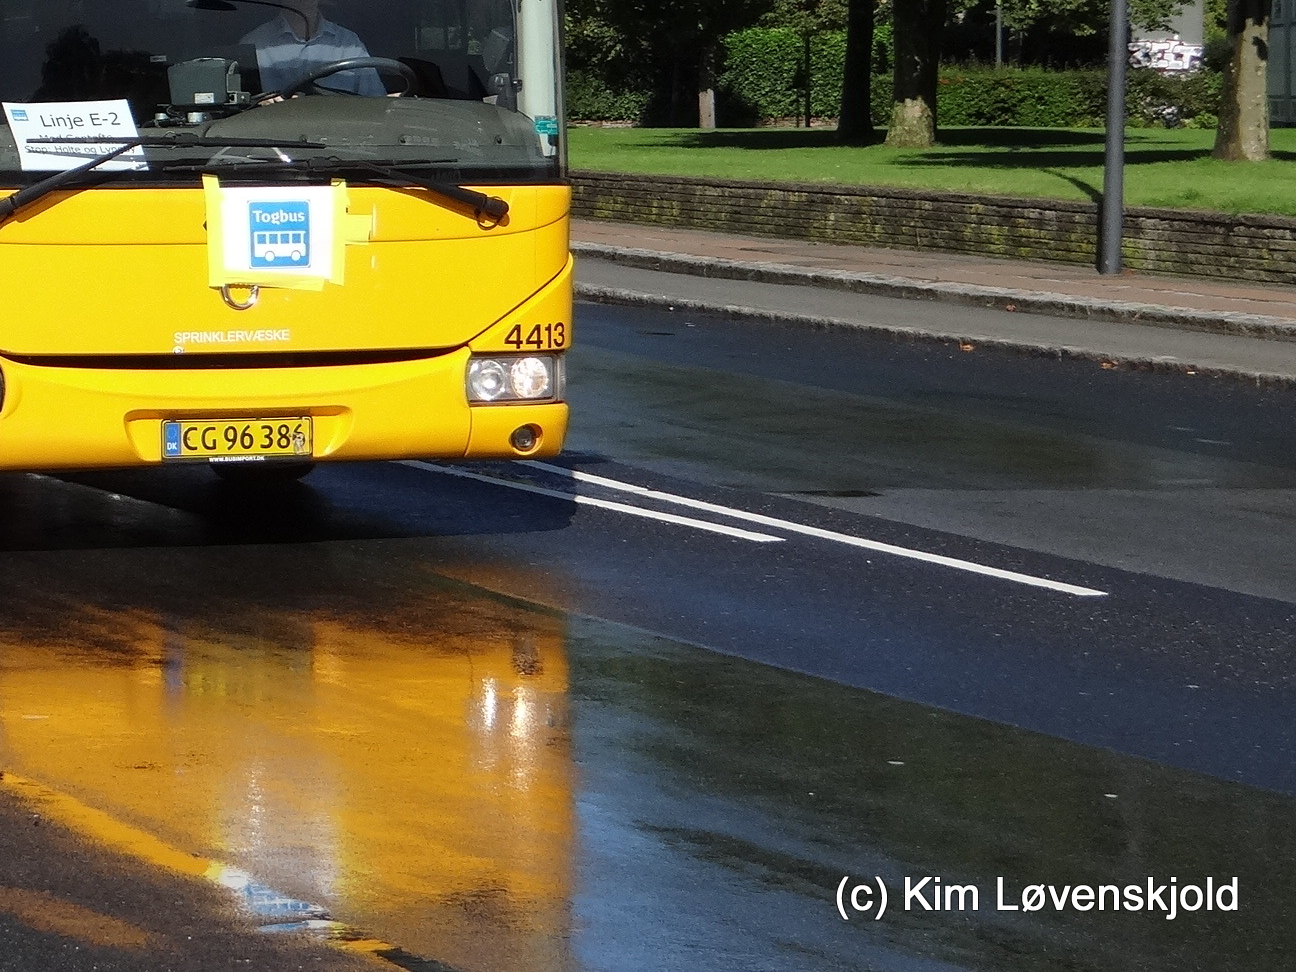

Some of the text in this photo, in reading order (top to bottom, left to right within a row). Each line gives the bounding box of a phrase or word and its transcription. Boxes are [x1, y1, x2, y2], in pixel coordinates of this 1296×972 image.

[39, 112, 121, 129] Linje E-2
[54, 145, 82, 154] Holte
[252, 208, 306, 225] Togbus
[174, 329, 290, 344] SPRINKLERVÆSKE
[504, 322, 565, 349] 4413
[167, 442, 178, 451] DK
[183, 426, 217, 451] CG
[224, 425, 254, 450] 96
